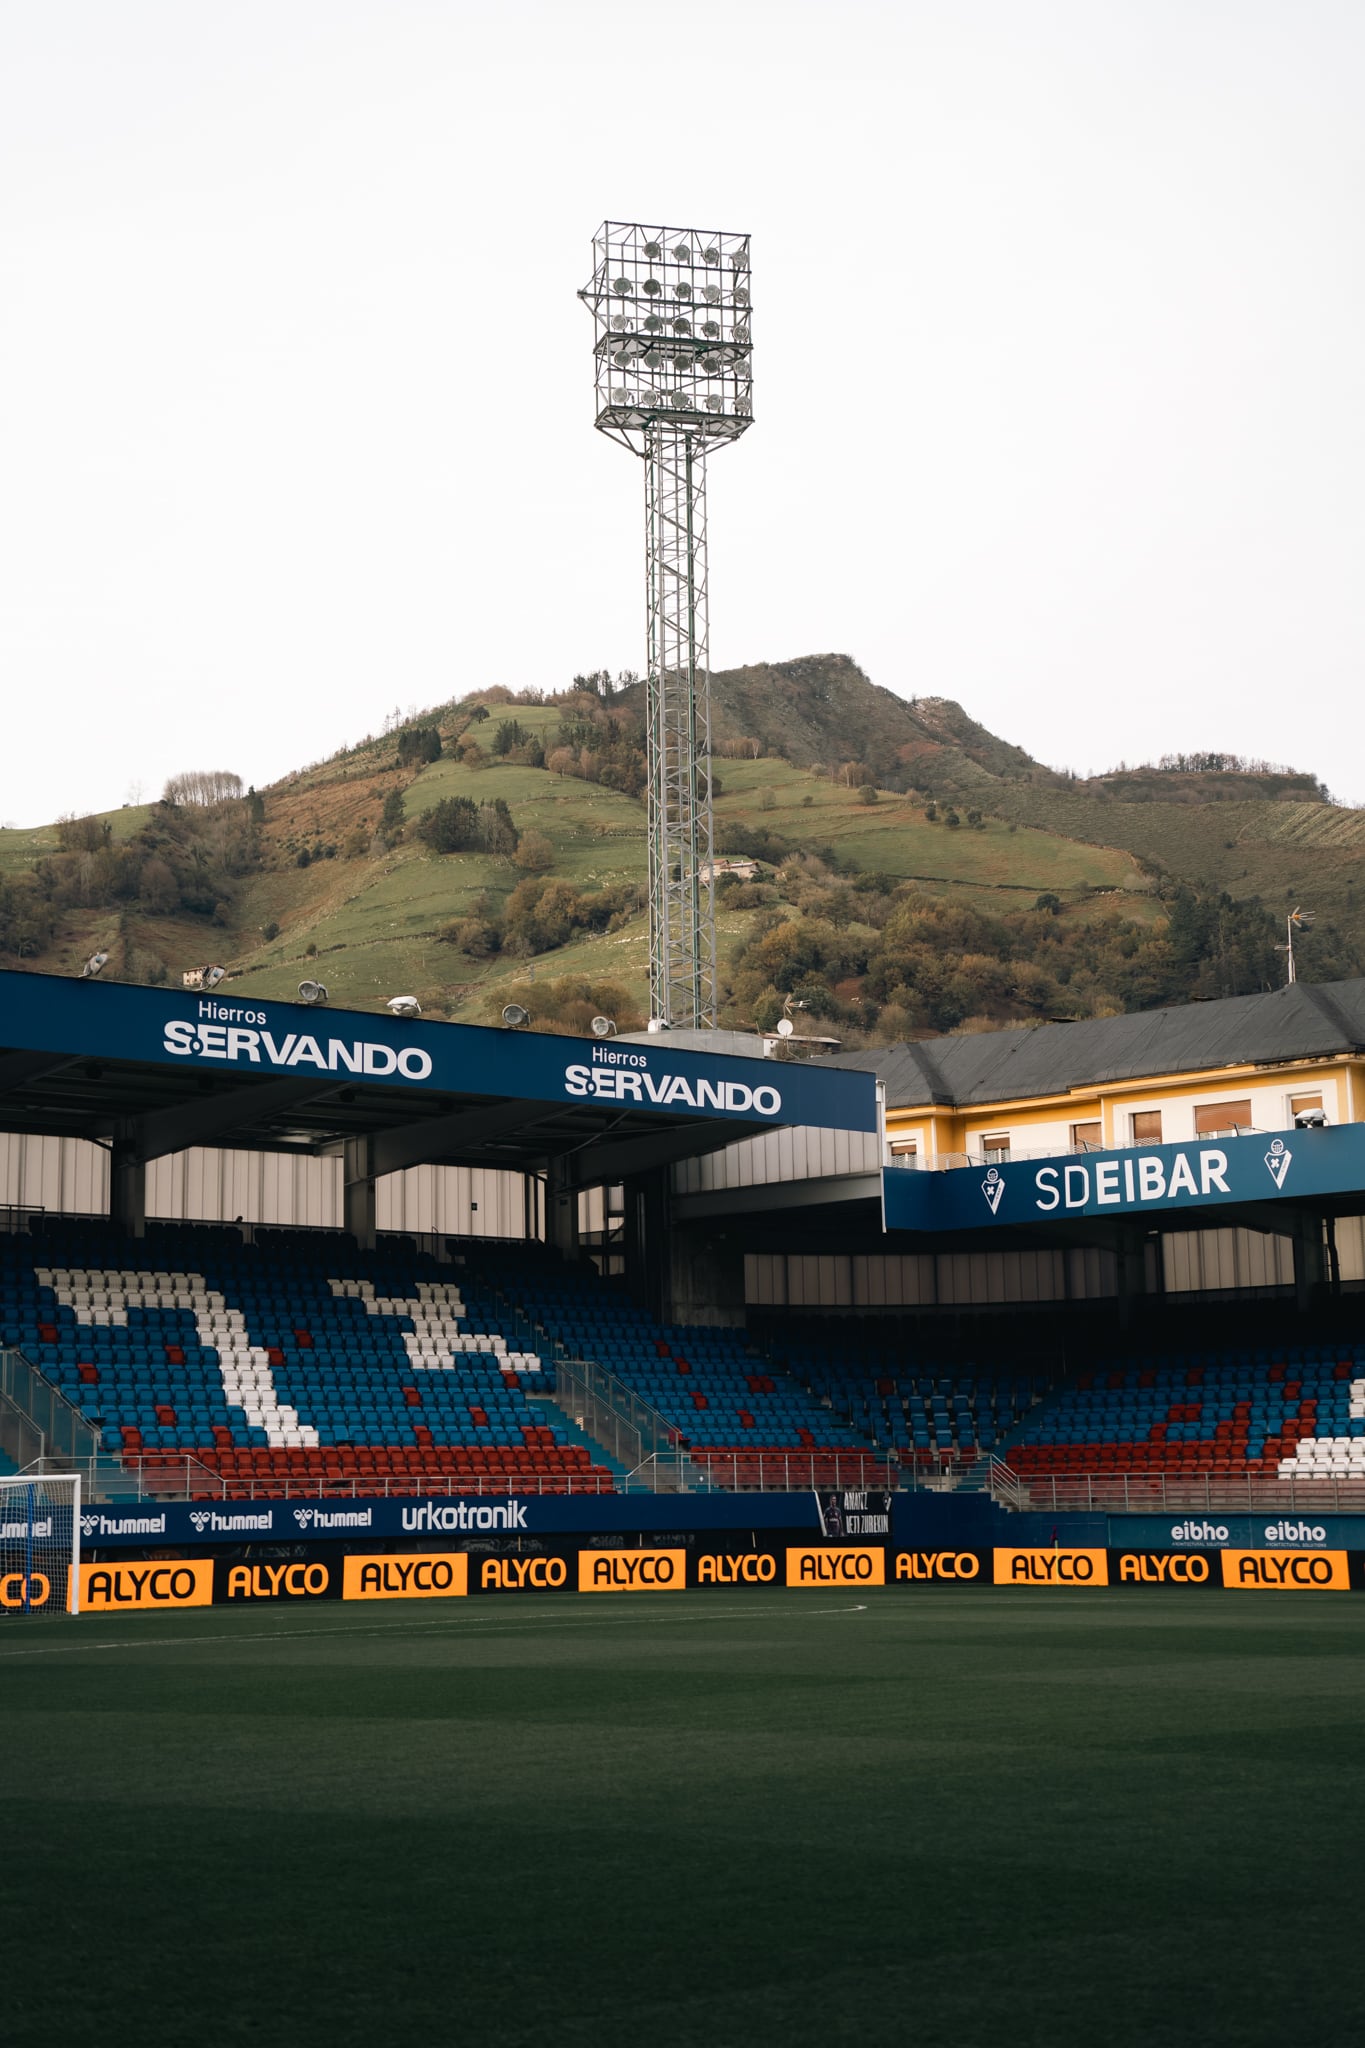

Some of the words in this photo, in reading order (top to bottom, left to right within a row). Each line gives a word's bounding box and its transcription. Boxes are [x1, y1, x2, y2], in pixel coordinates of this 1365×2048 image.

[198, 1001, 267, 1024] Hierros
[163, 1020, 432, 1080] SERVANDO
[592, 1047, 647, 1068] Hierros
[564, 1065, 782, 1115] SERVANDO
[100, 1513, 166, 1535] hummel
[211, 1510, 273, 1531] hummel
[313, 1508, 372, 1528] hummel
[402, 1500, 528, 1531] urkotronik
[1171, 1521, 1229, 1540] eibho
[1265, 1521, 1326, 1541] eibho
[361, 1561, 453, 1592] ALYCO
[482, 1558, 567, 1588] ALYCO
[594, 1557, 674, 1584] ALYCO
[698, 1555, 776, 1582] ALYCO
[801, 1554, 873, 1580] ALYCO
[896, 1553, 980, 1579] ALYCO
[1012, 1555, 1093, 1580] ALYCO
[1119, 1555, 1209, 1582] ALYCO
[1239, 1557, 1332, 1584] ALYCO
[88, 1569, 195, 1602] ALYCO
[229, 1564, 329, 1597] ALYCO
